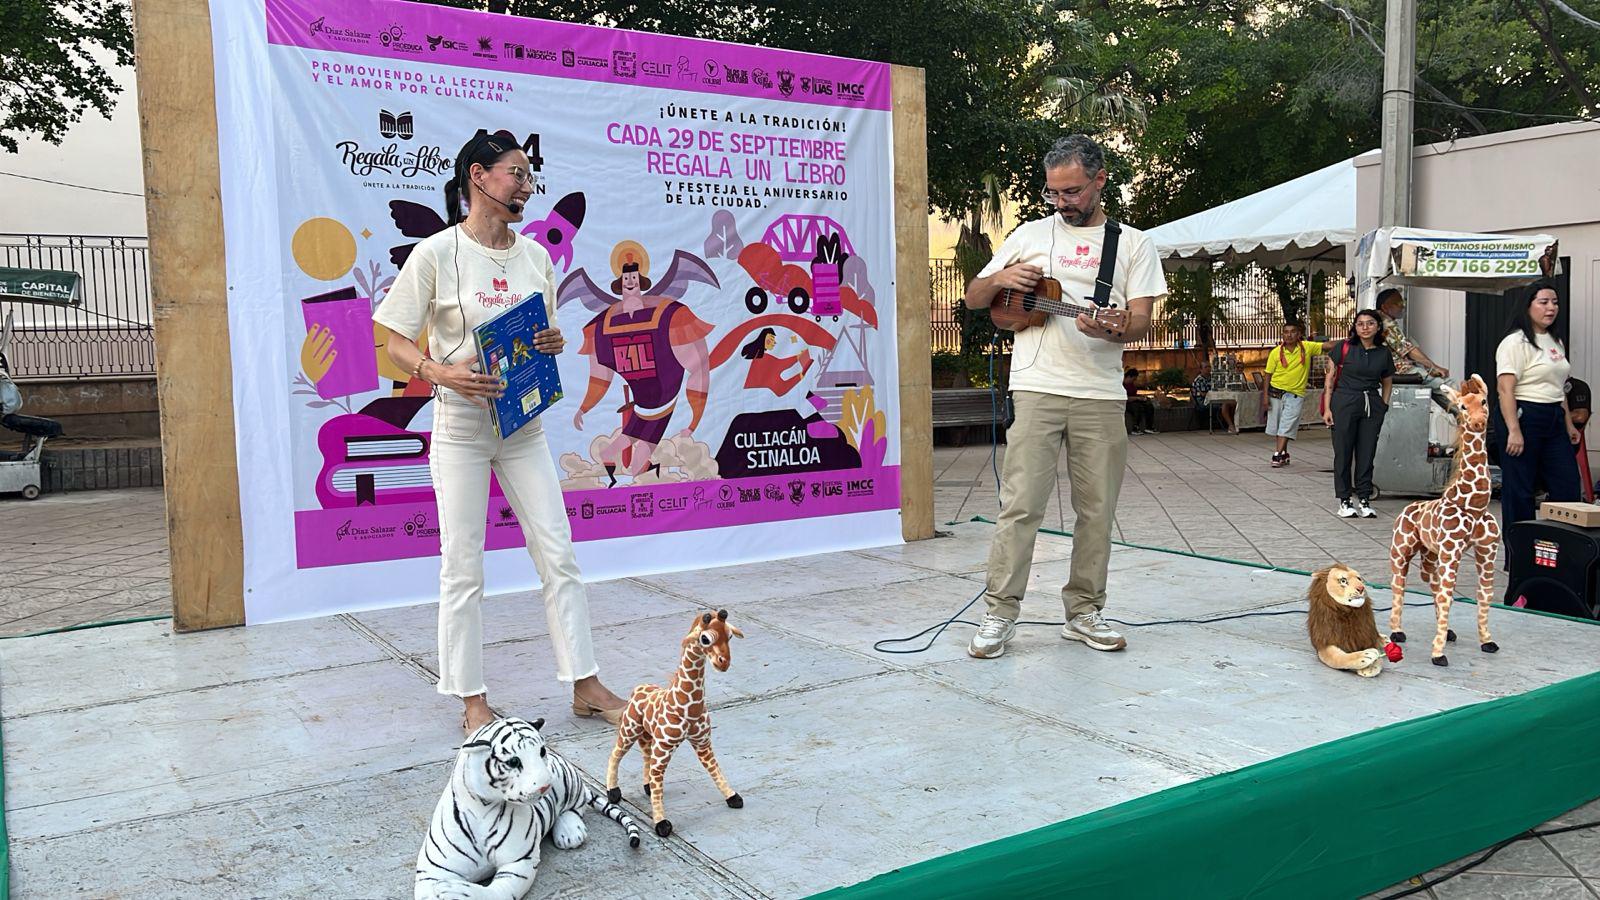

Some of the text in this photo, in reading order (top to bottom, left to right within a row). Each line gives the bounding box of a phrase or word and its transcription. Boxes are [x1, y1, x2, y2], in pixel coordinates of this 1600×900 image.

[344, 29, 371, 39] Salazar
[641, 61, 672, 75] CELIT
[312, 61, 514, 92] PROMOVIENDO LA LECTURA
[312, 73, 509, 103] Y EL AMOR POR CULIACÁN.
[815, 83, 833, 95] UAS
[837, 82, 864, 95] IMCC
[660, 102, 847, 133] ¡ÚNETE A LA TRADICIÓN!
[607, 121, 846, 161] CADA 29 DE SEPTIEMBRE
[335, 141, 402, 177] Regala
[402, 145, 457, 177] Libro
[647, 151, 846, 186] REGALA UN LIBRO
[363, 181, 384, 189] ÚNETE
[665, 181, 848, 201] Y FESTEJA EL ANIVERSARIO
[666, 193, 768, 209] DE LA CIUDAD.
[1503, 243, 1535, 251] MISMO
[1426, 259, 1538, 274] 667 166 2929
[21, 281, 70, 293] CAPITAL
[734, 426, 806, 449] CULIACÁN
[746, 446, 821, 469] SINALOA
[825, 485, 843, 496] UAS
[847, 479, 873, 490] IMCC
[659, 496, 688, 509] CELIT
[370, 525, 396, 534] Salazar
